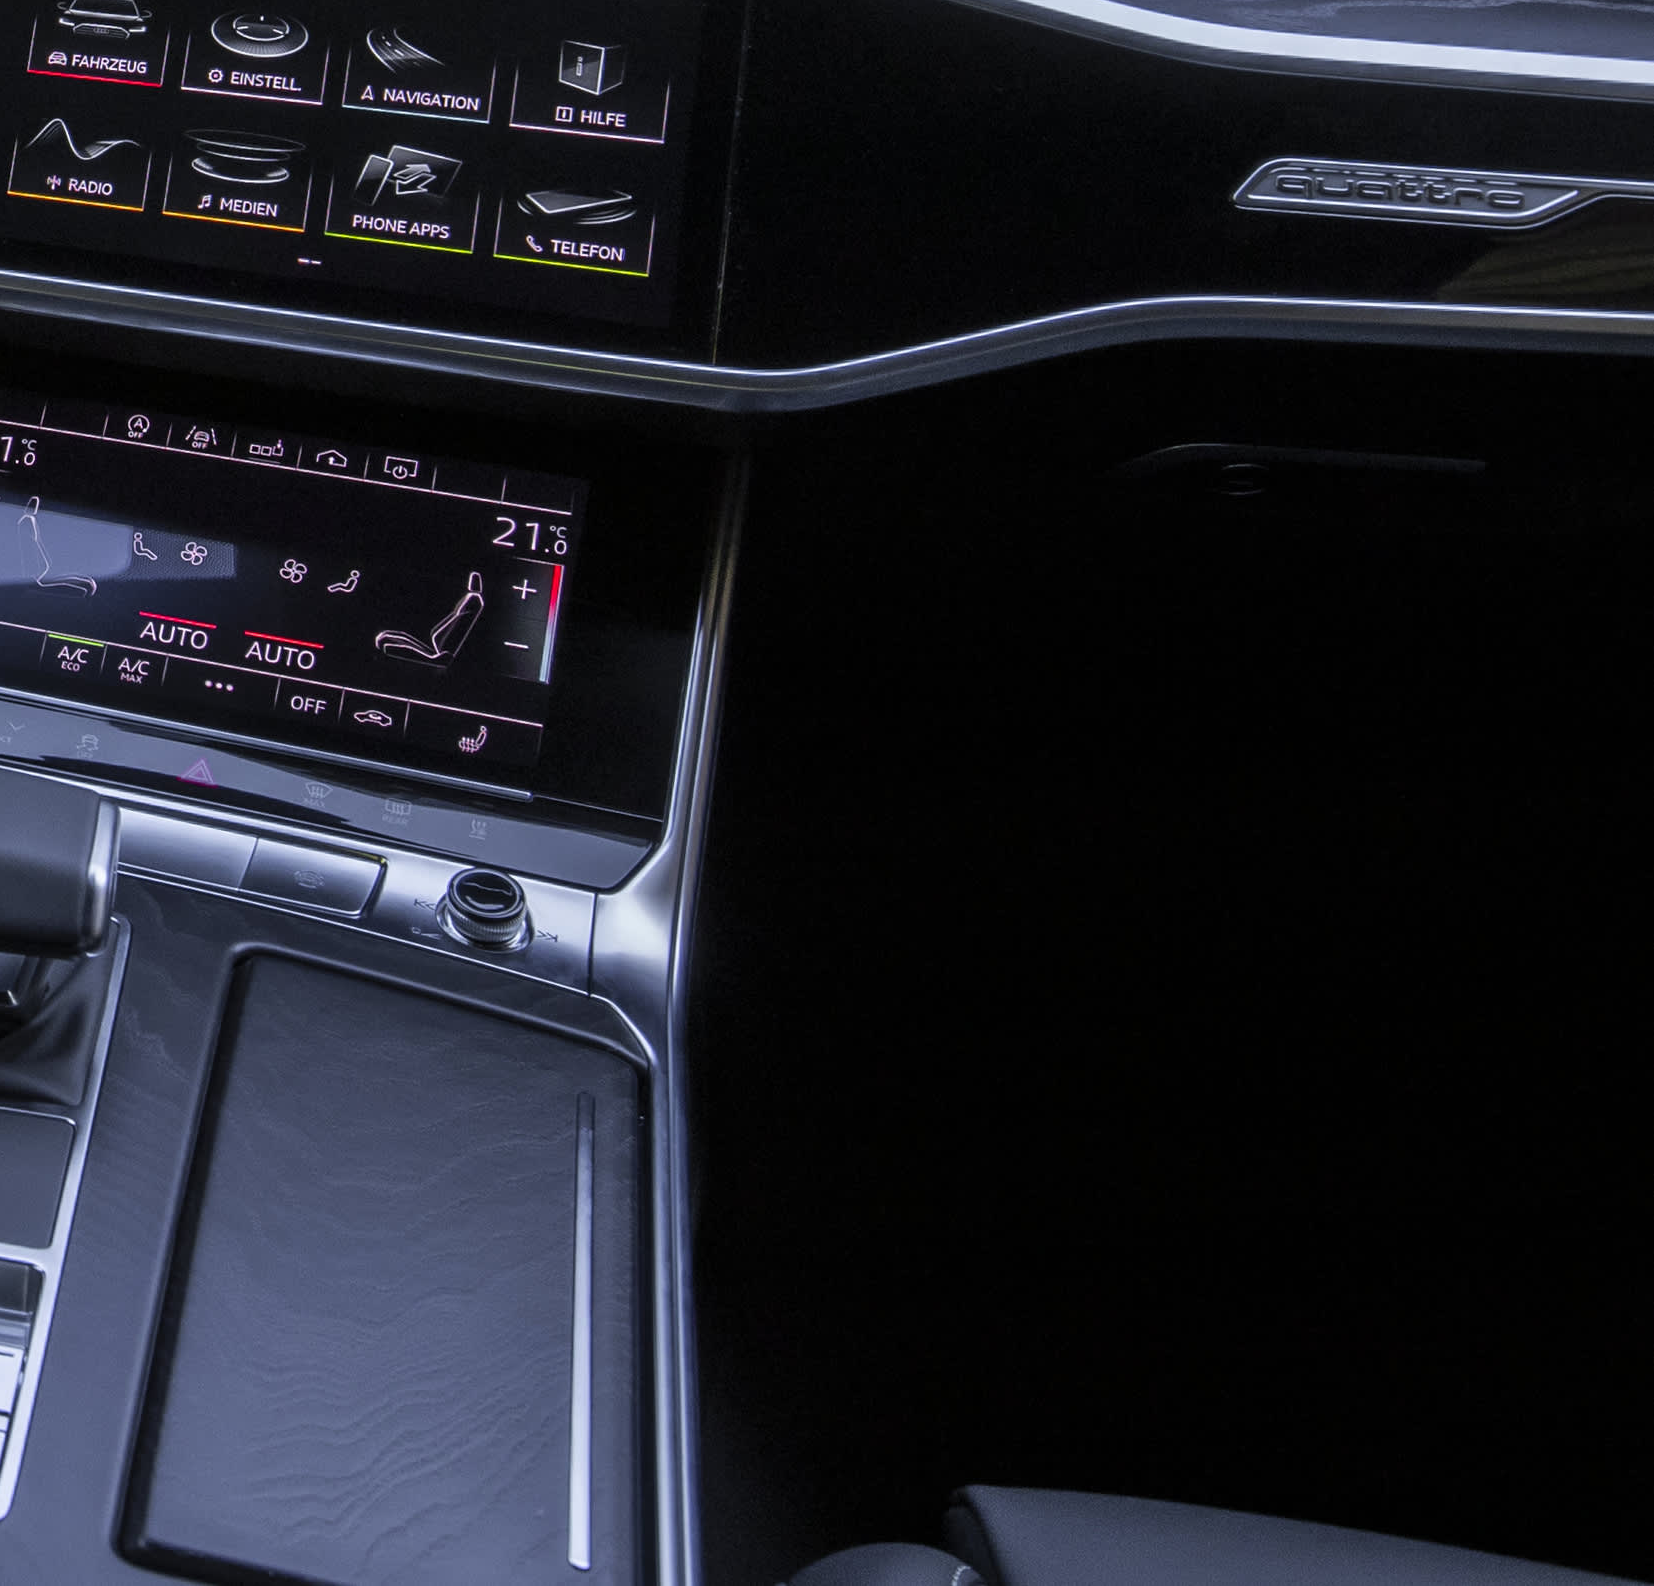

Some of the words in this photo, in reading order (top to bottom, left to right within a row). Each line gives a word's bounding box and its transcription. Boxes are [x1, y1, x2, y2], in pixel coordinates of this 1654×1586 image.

[71, 54, 147, 74] FAHRZEUG
[230, 71, 302, 92] EINSTELL.
[383, 87, 481, 112] NAVIGATION
[580, 109, 627, 127] HILFE
[68, 178, 113, 196] RADIO
[1275, 174, 1525, 209] quattro
[219, 197, 278, 217] MEDIEN
[352, 214, 407, 234] PHONE
[409, 222, 450, 239] APPS
[550, 239, 624, 261] TELEFON
[191, 440, 208, 450] OFF
[140, 621, 208, 650] AUTO
[57, 645, 89, 665] A/C
[244, 641, 316, 670] AUTO
[61, 660, 81, 672] ECO
[118, 656, 150, 677] A/C
[120, 672, 143, 685] MAX
[290, 695, 327, 715] OFF
